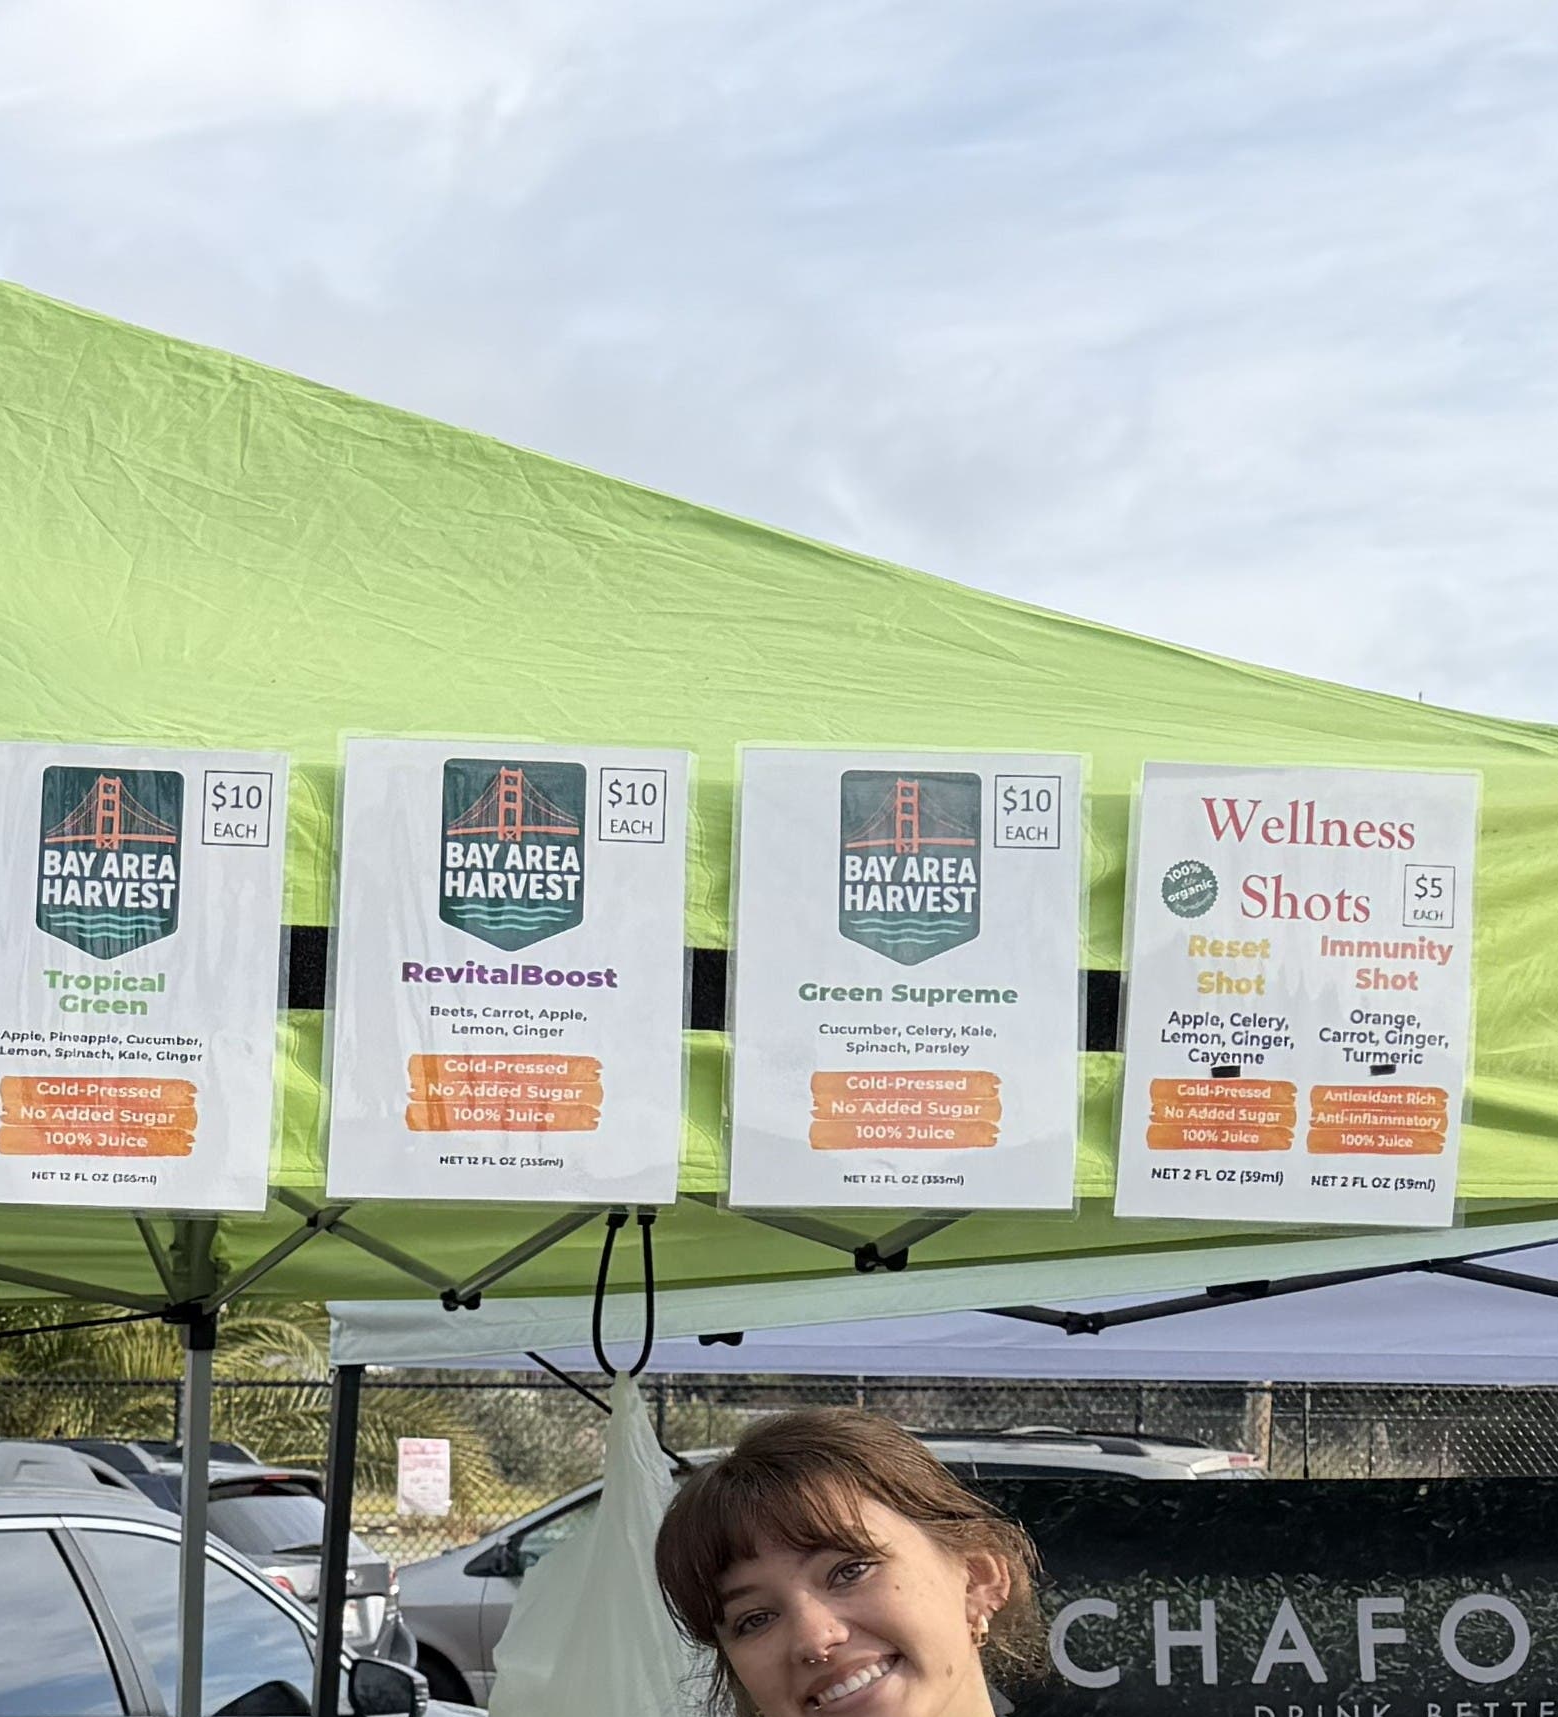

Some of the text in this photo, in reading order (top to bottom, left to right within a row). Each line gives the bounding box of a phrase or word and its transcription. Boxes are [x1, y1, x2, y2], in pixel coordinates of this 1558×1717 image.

[608, 779, 657, 808] $10
[1003, 785, 1052, 815] $10
[610, 819, 653, 835] EACH
[1006, 826, 1047, 841] EACH
[1201, 797, 1415, 850] Wellness
[446, 842, 580, 872] BAY AREA
[1167, 862, 1202, 883] 100%
[444, 871, 580, 901] HARVEST
[1167, 878, 1213, 903] organic
[1415, 874, 1443, 899] $5
[1240, 873, 1371, 923] Shots
[1188, 935, 1271, 959] Reset
[1321, 935, 1453, 965] Immunity
[43, 969, 165, 995] Tropical
[402, 961, 618, 988] RevitalBoost
[1197, 971, 1266, 995] Shot
[1355, 968, 1419, 991] Shot
[59, 994, 148, 1016] Green
[799, 983, 1018, 1007] Green Supreme
[430, 1006, 587, 1021] Beets, Carrot, Apple,
[1168, 1010, 1290, 1031] Apple, Celery,
[1350, 1009, 1421, 1028] Orange,
[452, 1023, 564, 1038] Lemon, Ginger
[819, 1023, 997, 1038] Cucumber, Celery, Kale,
[1161, 1029, 1295, 1050] Lemon, Ginger,
[1319, 1028, 1449, 1048] Carrot, Ginger,
[846, 1042, 970, 1056] Spinach, Parsley
[1188, 1048, 1264, 1066] Cayenne
[1343, 1048, 1423, 1065] Turmeric
[1049, 1594, 1530, 1688] CHAFO
